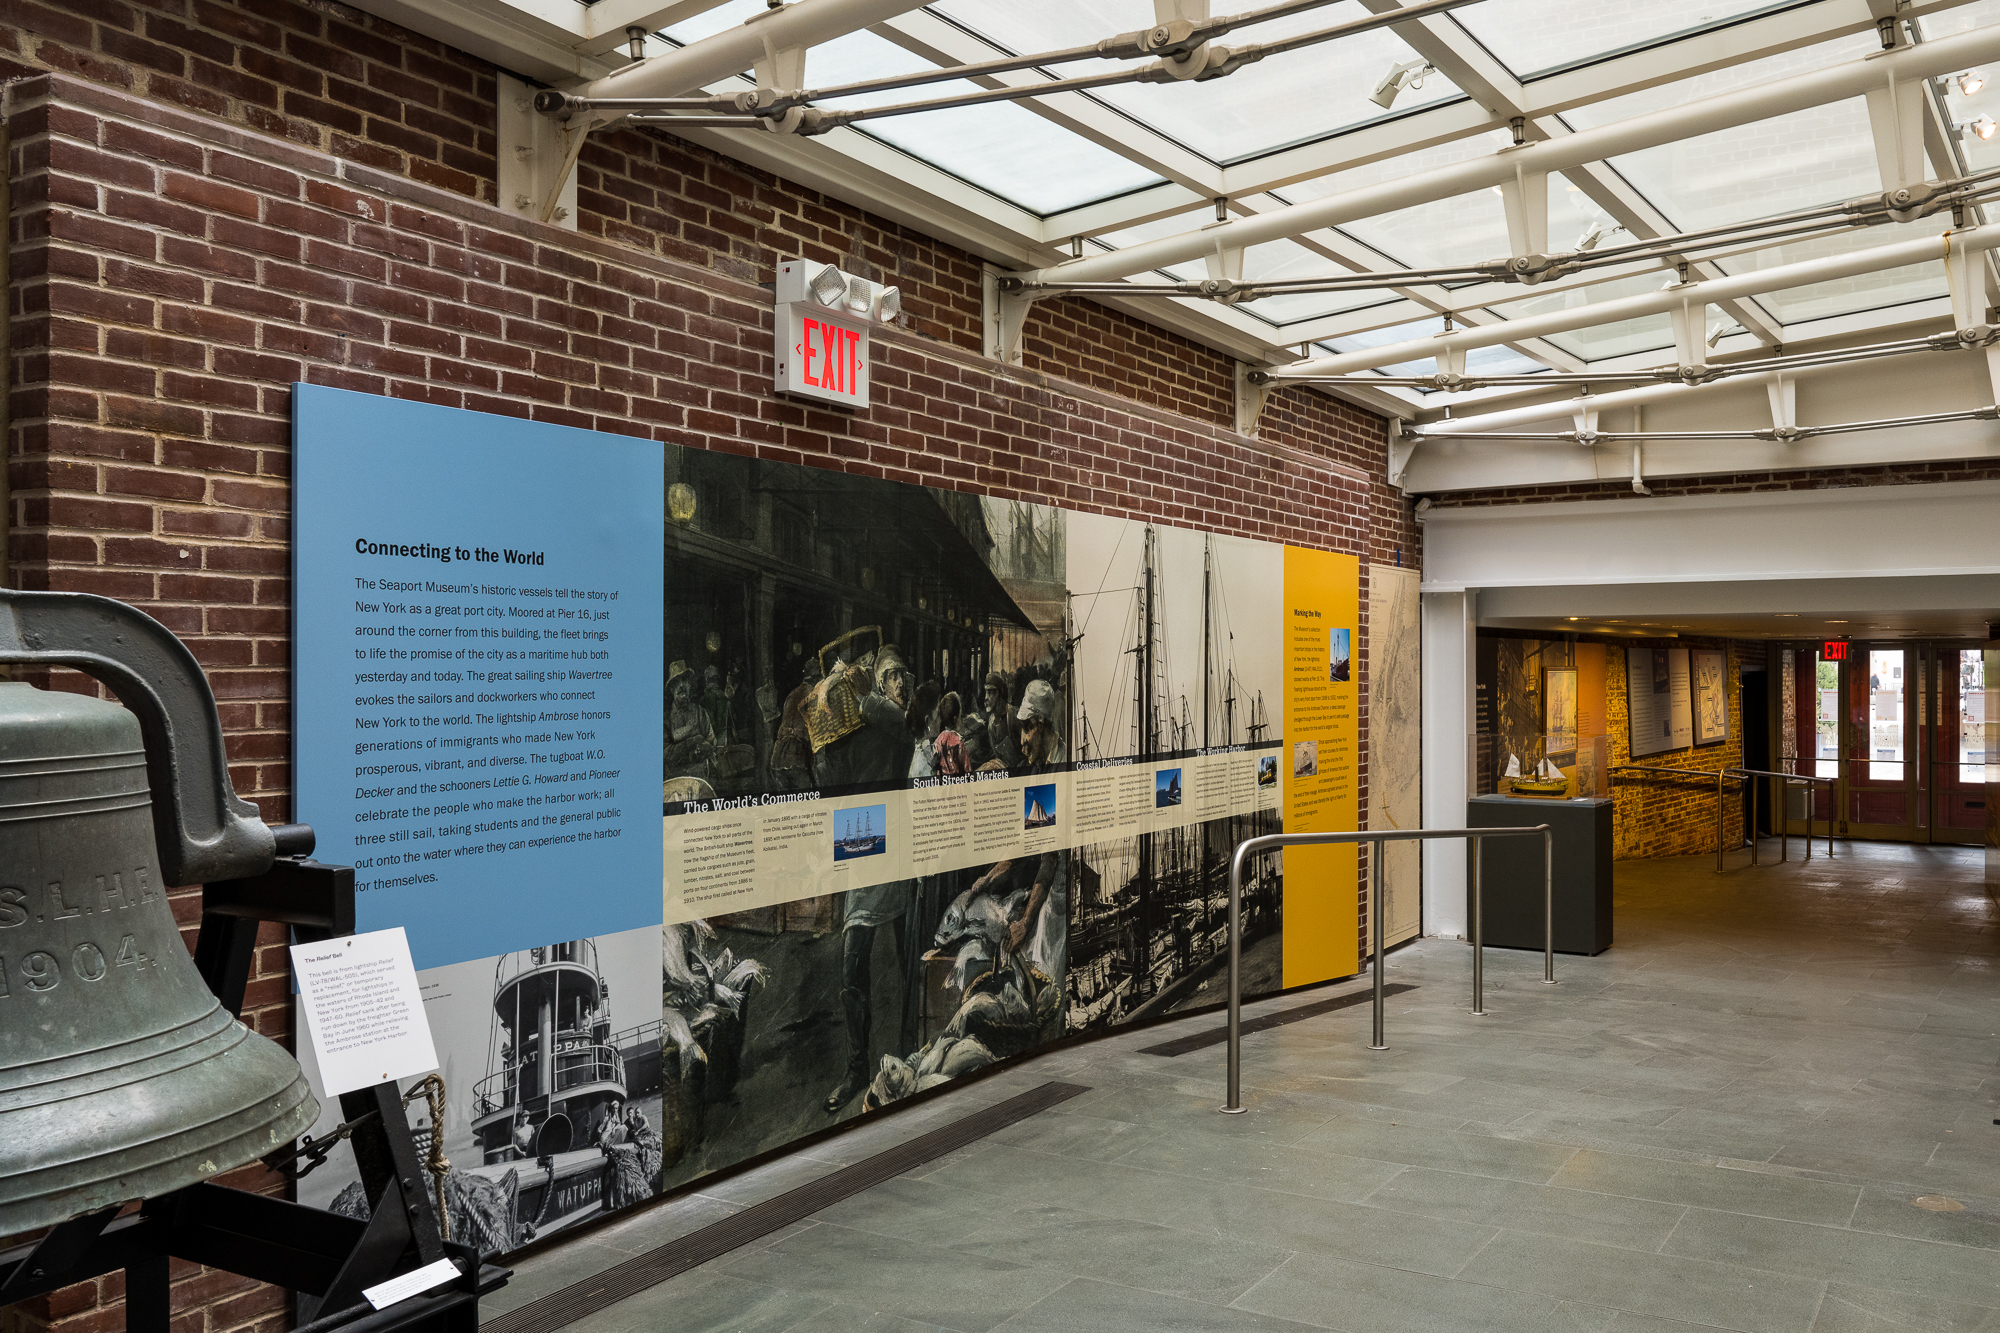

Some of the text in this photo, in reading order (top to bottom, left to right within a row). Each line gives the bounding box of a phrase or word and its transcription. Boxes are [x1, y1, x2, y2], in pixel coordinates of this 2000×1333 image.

[804, 317, 860, 396] EXIT
[356, 538, 544, 566] Connecting to the World
[355, 578, 618, 602] The Seaport Museum's historic vessels tell the story of
[356, 601, 610, 622] New York as a great port city. Moored at Pier 16, just
[355, 625, 609, 642] around the corner from this building, the fleet brings
[1824, 642, 1848, 659] EXIT
[355, 670, 612, 685] yesterday and today. The great sailing ship Wavertree
[355, 690, 596, 706] evokes the sailors and dockworkers who connect
[356, 710, 611, 729] New York to the world. The lightship Ambrose honors
[1196, 749, 1206, 757] The
[356, 749, 606, 778] prosperous, vibrant, and diverse. The tugboat W.O.
[1076, 757, 1133, 771] Coastal Deliveries
[356, 770, 621, 799] Decker and the schooners Lettie G. Howard and Pioneer
[913, 770, 1009, 789] South Street's Markets
[683, 790, 821, 814] The World's Commerce
[355, 808, 621, 846] three still sail, taking students and the general public
[354, 962, 377, 970] lightship
[354, 976, 383, 985] temporary
[314, 990, 351, 1000] replacement,
[361, 983, 387, 991] lightships
[327, 1045, 352, 1053] entrance
